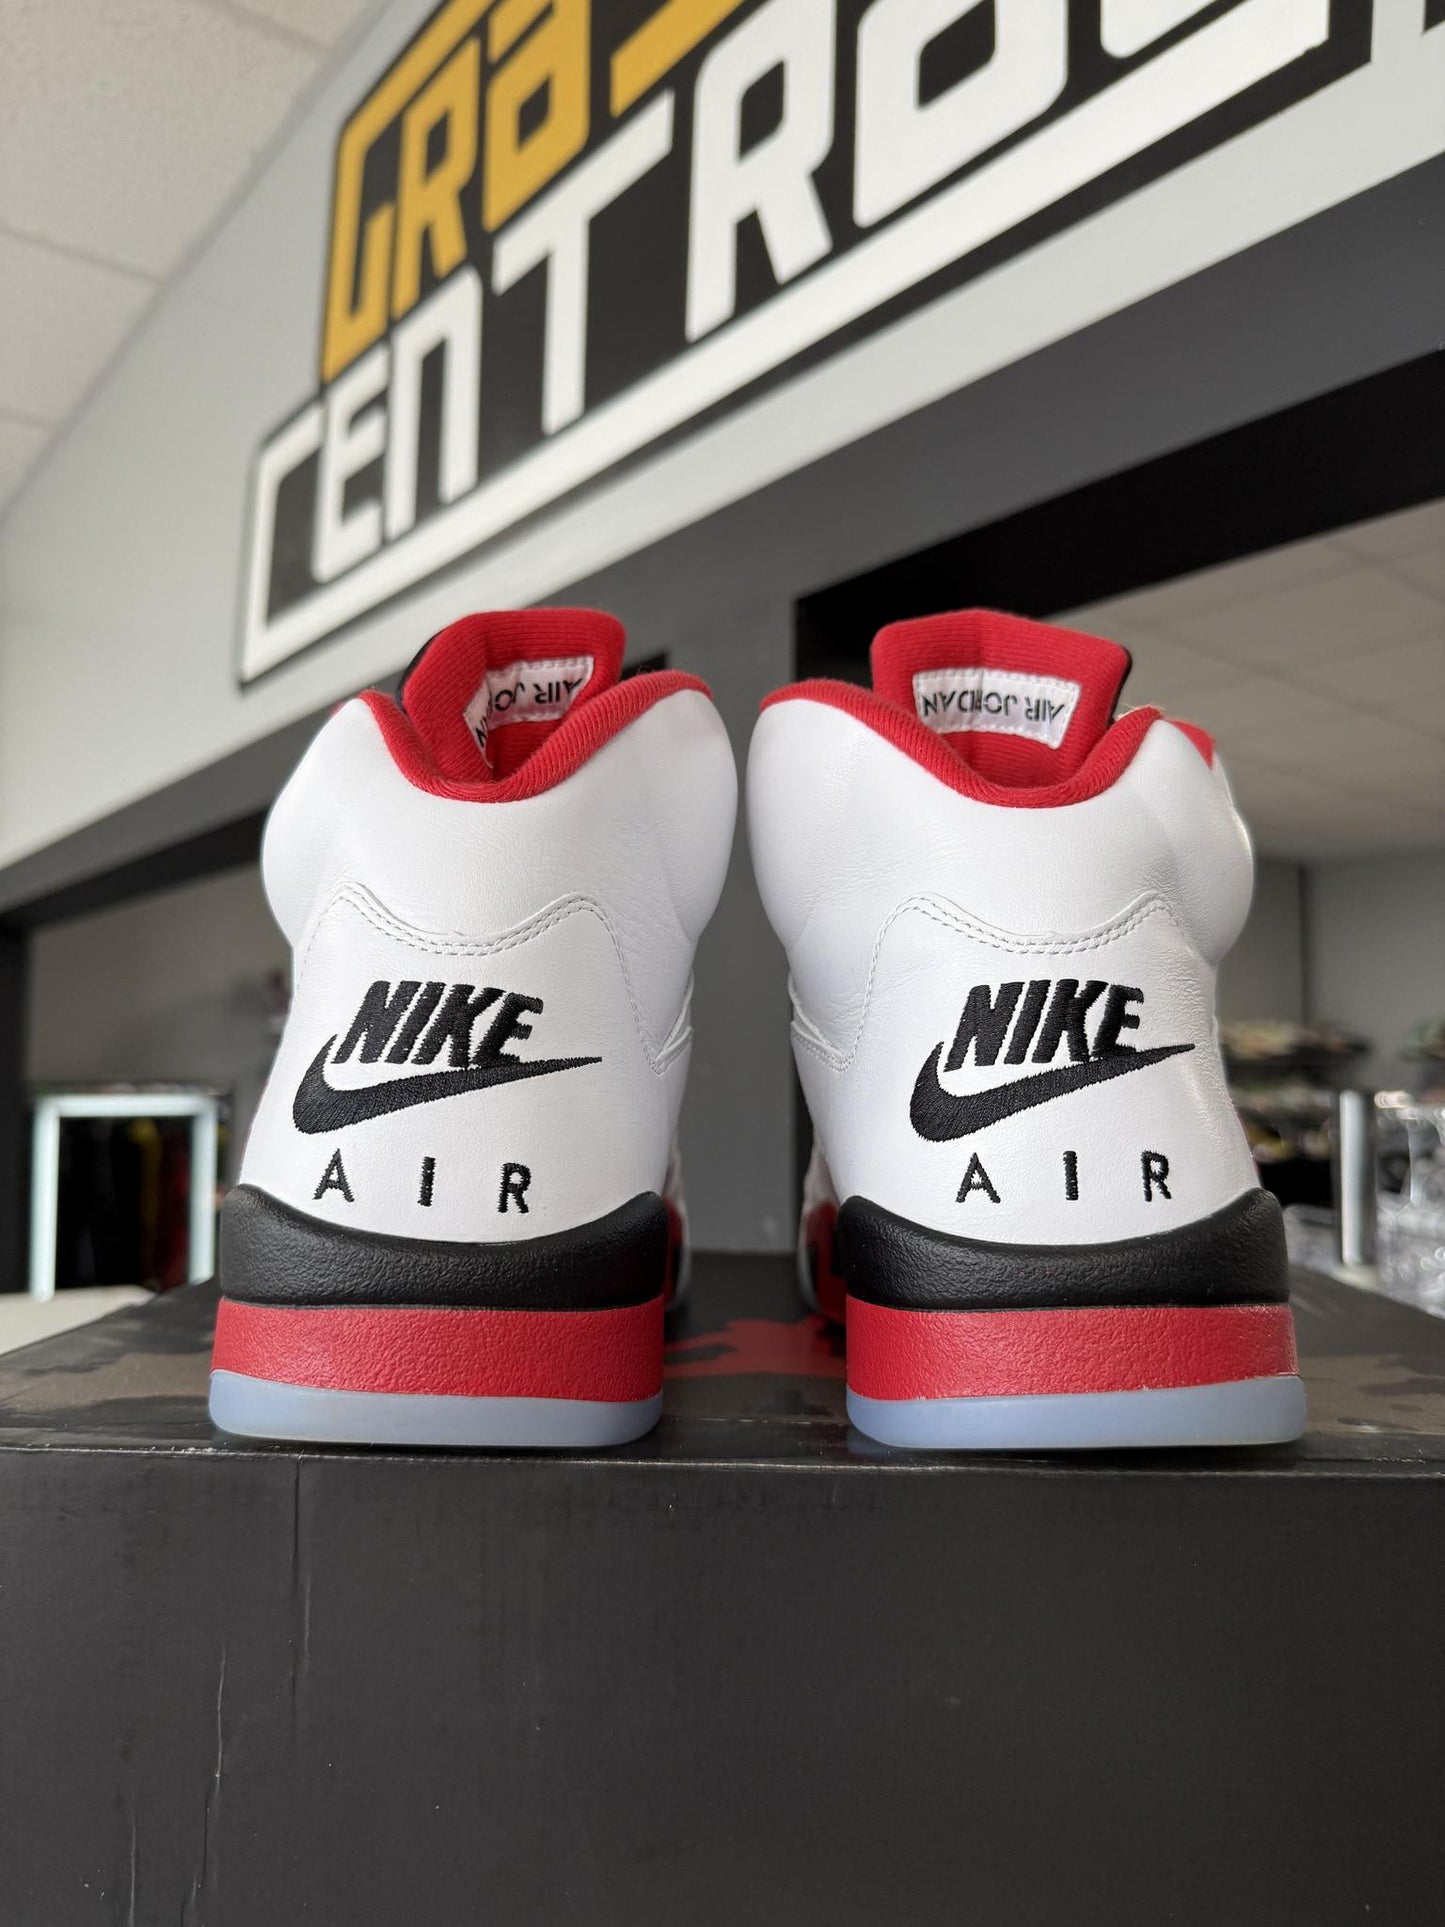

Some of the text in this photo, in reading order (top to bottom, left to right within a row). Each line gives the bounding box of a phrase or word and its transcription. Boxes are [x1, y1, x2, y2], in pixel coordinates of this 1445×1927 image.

[534, 678, 583, 705] AIR
[1024, 697, 1065, 724] AIR
[331, 980, 544, 1068] NIKE
[944, 979, 1144, 1072] NIKE
[313, 1148, 532, 1213] AIR
[955, 1150, 1172, 1203] AIR
